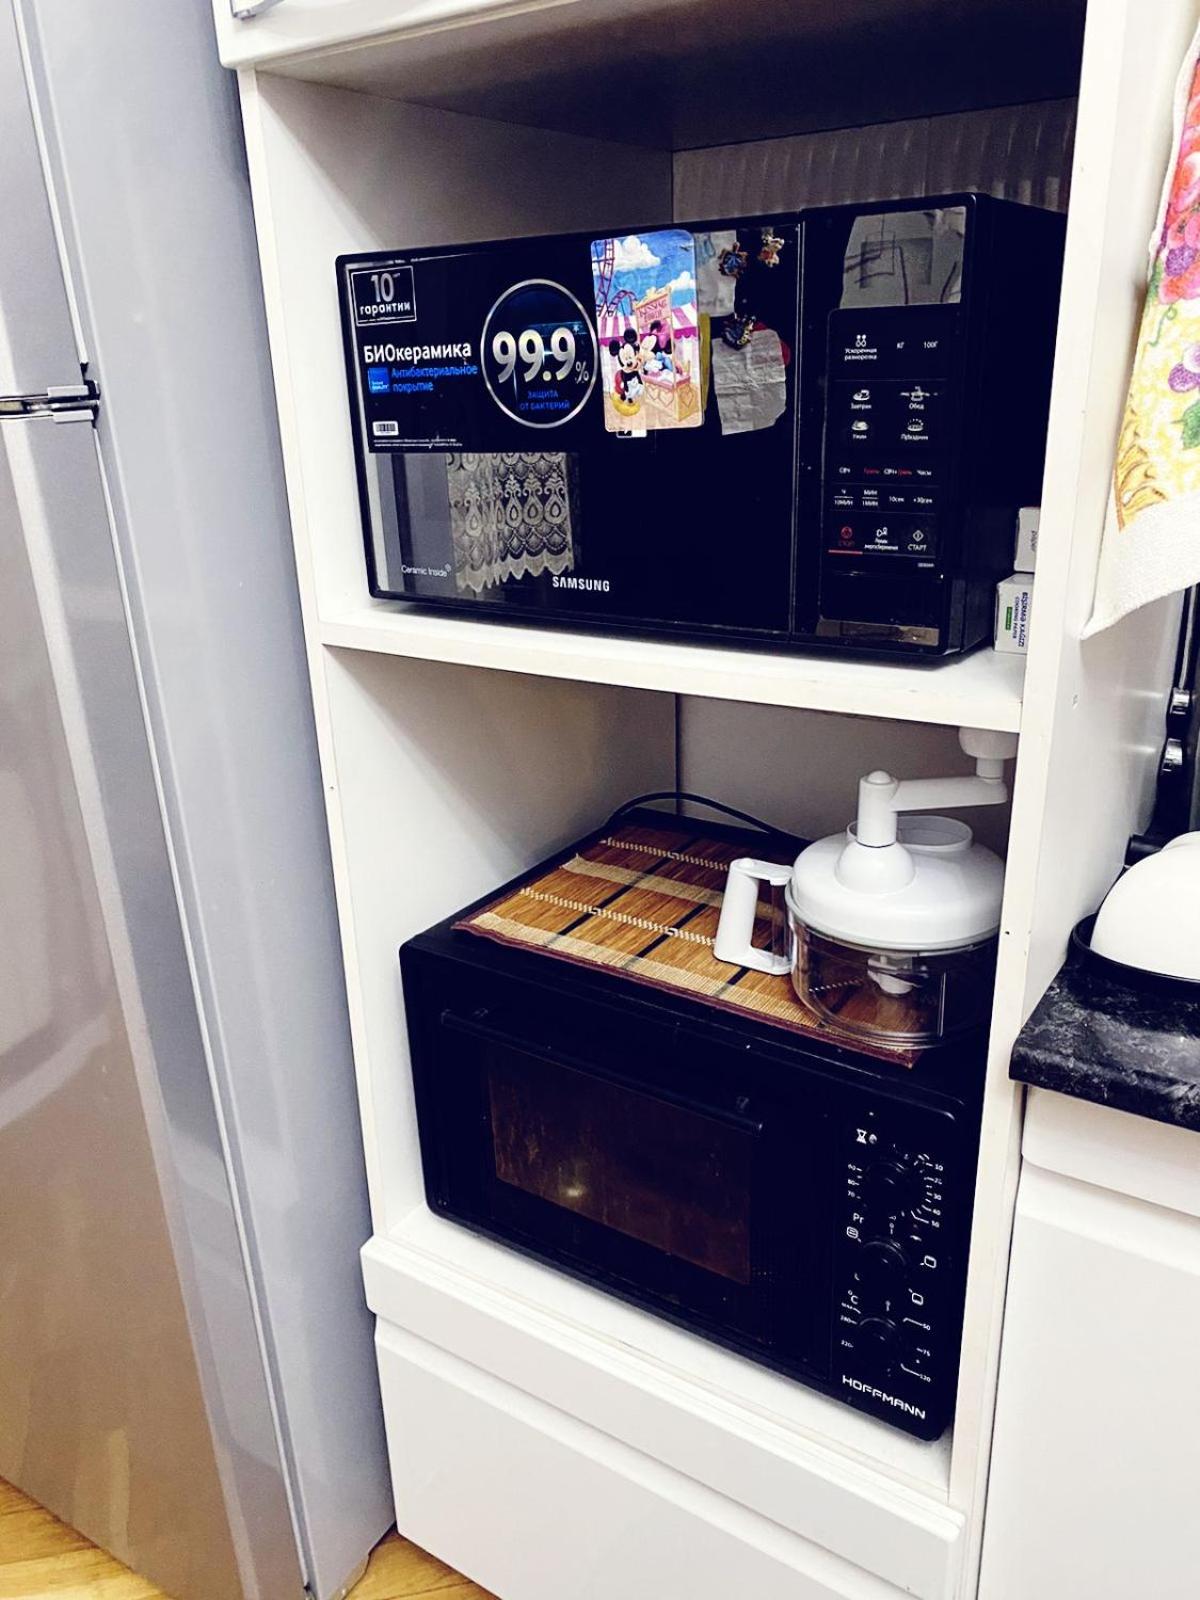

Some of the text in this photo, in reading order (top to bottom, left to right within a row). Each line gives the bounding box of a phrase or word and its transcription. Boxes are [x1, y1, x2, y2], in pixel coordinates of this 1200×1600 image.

[370, 273, 395, 302] 10
[360, 302, 411, 316] гарантии
[363, 342, 472, 365] БИОкерамика
[391, 364, 478, 378] Антибактериальное
[392, 381, 434, 394] покрытие
[527, 390, 559, 399] ЗАЩИТА
[519, 400, 571, 410] ОТ БАКТЕРИЙ
[401, 564, 448, 578] Ceramic Inside
[552, 576, 610, 593] SAMSUNG
[842, 1375, 926, 1419] HOFFMANN
